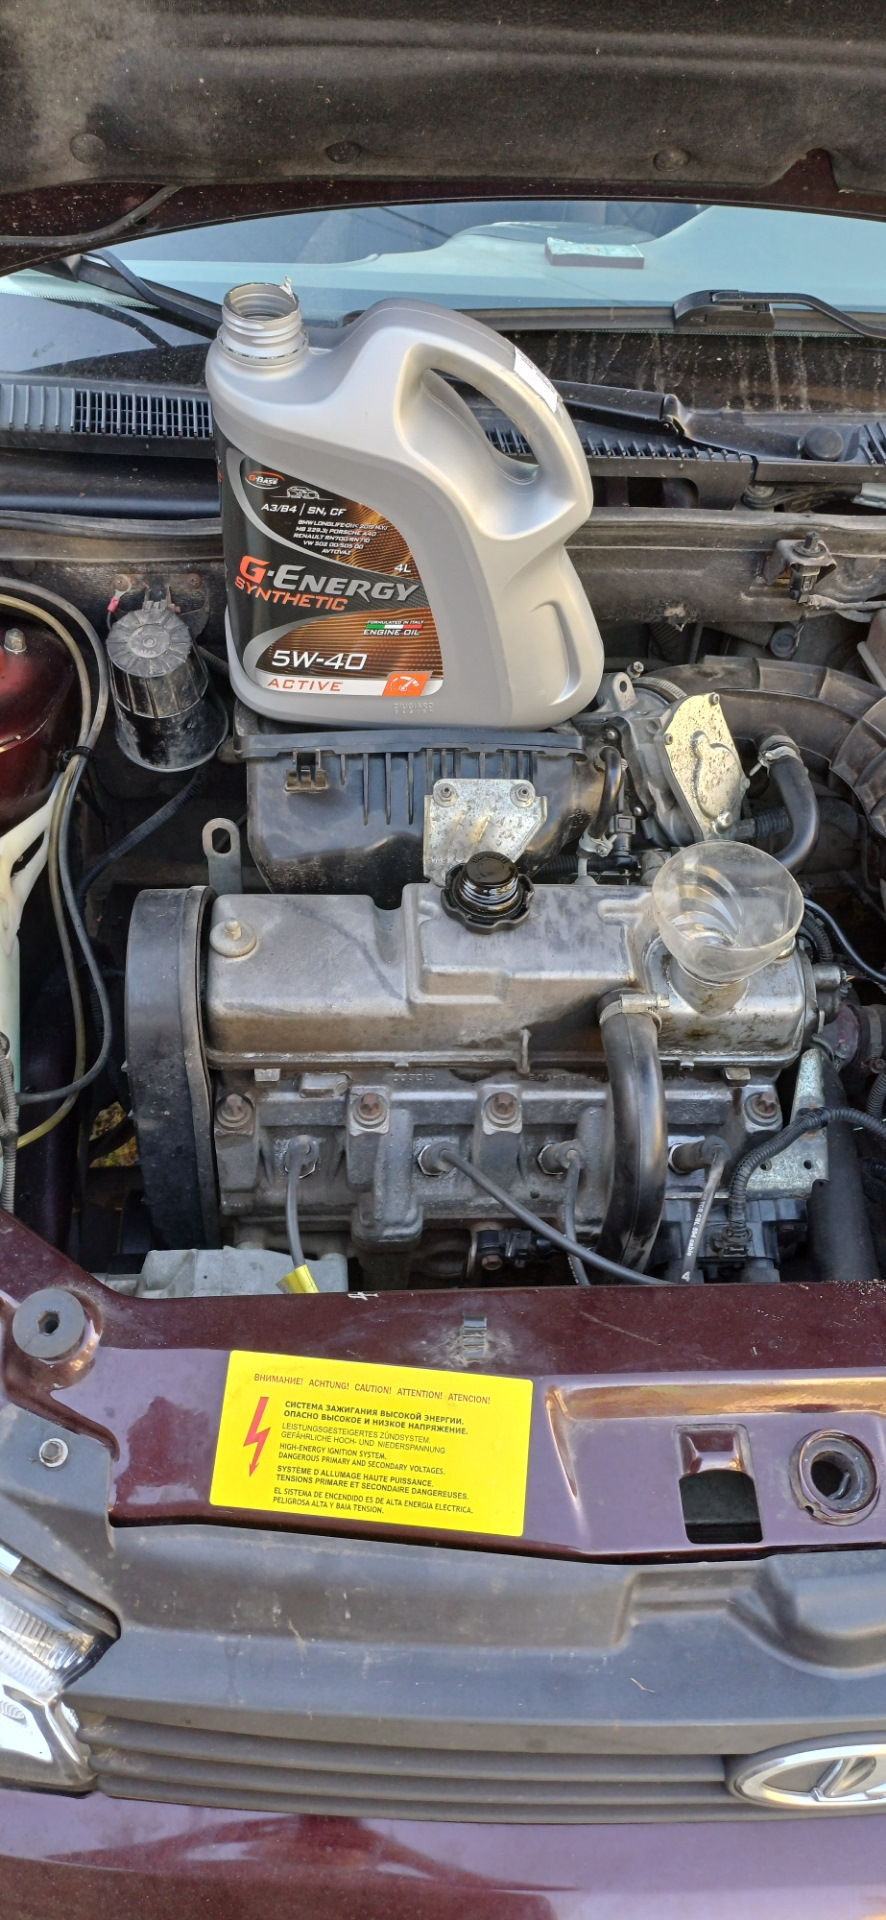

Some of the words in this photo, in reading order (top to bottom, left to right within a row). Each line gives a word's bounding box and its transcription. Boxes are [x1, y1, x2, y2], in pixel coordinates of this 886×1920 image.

[248, 474, 278, 485] G-BASE
[261, 504, 298, 513] A3/B4
[307, 506, 326, 516] SN,
[330, 508, 347, 516] CF
[328, 528, 360, 536] PORSCHE
[394, 564, 411, 573] 4L
[234, 576, 348, 611] SYNTHETIC
[271, 650, 368, 671] 5W-40
[268, 678, 343, 692] ACTIVE
[254, 1373, 303, 1385] ВНИМАНИЕ!
[309, 1379, 349, 1390] ACHTUNG!
[354, 1383, 392, 1394] CAUTION!
[397, 1388, 443, 1399] ATTENTION!
[448, 1393, 490, 1404] ATENCION!
[285, 1401, 323, 1411] СИСТЕМА
[326, 1405, 377, 1416] ЗАЖИГАНИЯ
[380, 1410, 421, 1420] ВЫСОКОЙ
[424, 1415, 464, 1425] ЭНЕРГИИ.
[282, 1422, 378, 1438] LEISTUNGSGESTEIGERTES
[284, 1410, 318, 1420] ОПАСНО
[321, 1414, 361, 1424] ВЫСОКОЕ
[372, 1419, 405, 1428] НИЗКОЕ
[408, 1423, 468, 1435] НАПРЯЖЕНИЕ.
[280, 1443, 326, 1453] HIGH-ENERGY
[327, 1447, 357, 1456] IGNITION
[359, 1451, 387, 1460] SYSTEM.
[333, 1437, 357, 1445] HOCH-
[358, 1439, 374, 1447] UND
[377, 1441, 445, 1454] NIEDERSPANNUNG
[279, 1452, 319, 1462] DANGEROUS
[321, 1456, 350, 1465] PRIMARY
[352, 1459, 366, 1467] AND
[367, 1461, 407, 1471] SECONDARY
[409, 1464, 445, 1475] VOLTAGES.
[276, 1474, 313, 1484] TENSIONS
[362, 1482, 410, 1494] SECONDAIRE
[411, 1487, 469, 1500] DANGEREUSES.
[363, 1473, 388, 1482] HAUTE
[390, 1476, 433, 1487] PUISSANCE.
[273, 1496, 310, 1506] PELIGROSA
[311, 1500, 328, 1508] ALTA
[353, 1504, 384, 1513] TENSION.
[284, 1488, 312, 1497] SISTEMA
[324, 1492, 363, 1502] ENCENDIDO
[366, 1496, 373, 1504] ES
[404, 1500, 433, 1510] ENERGIA
[435, 1503, 473, 1513] ELECTRICA.
